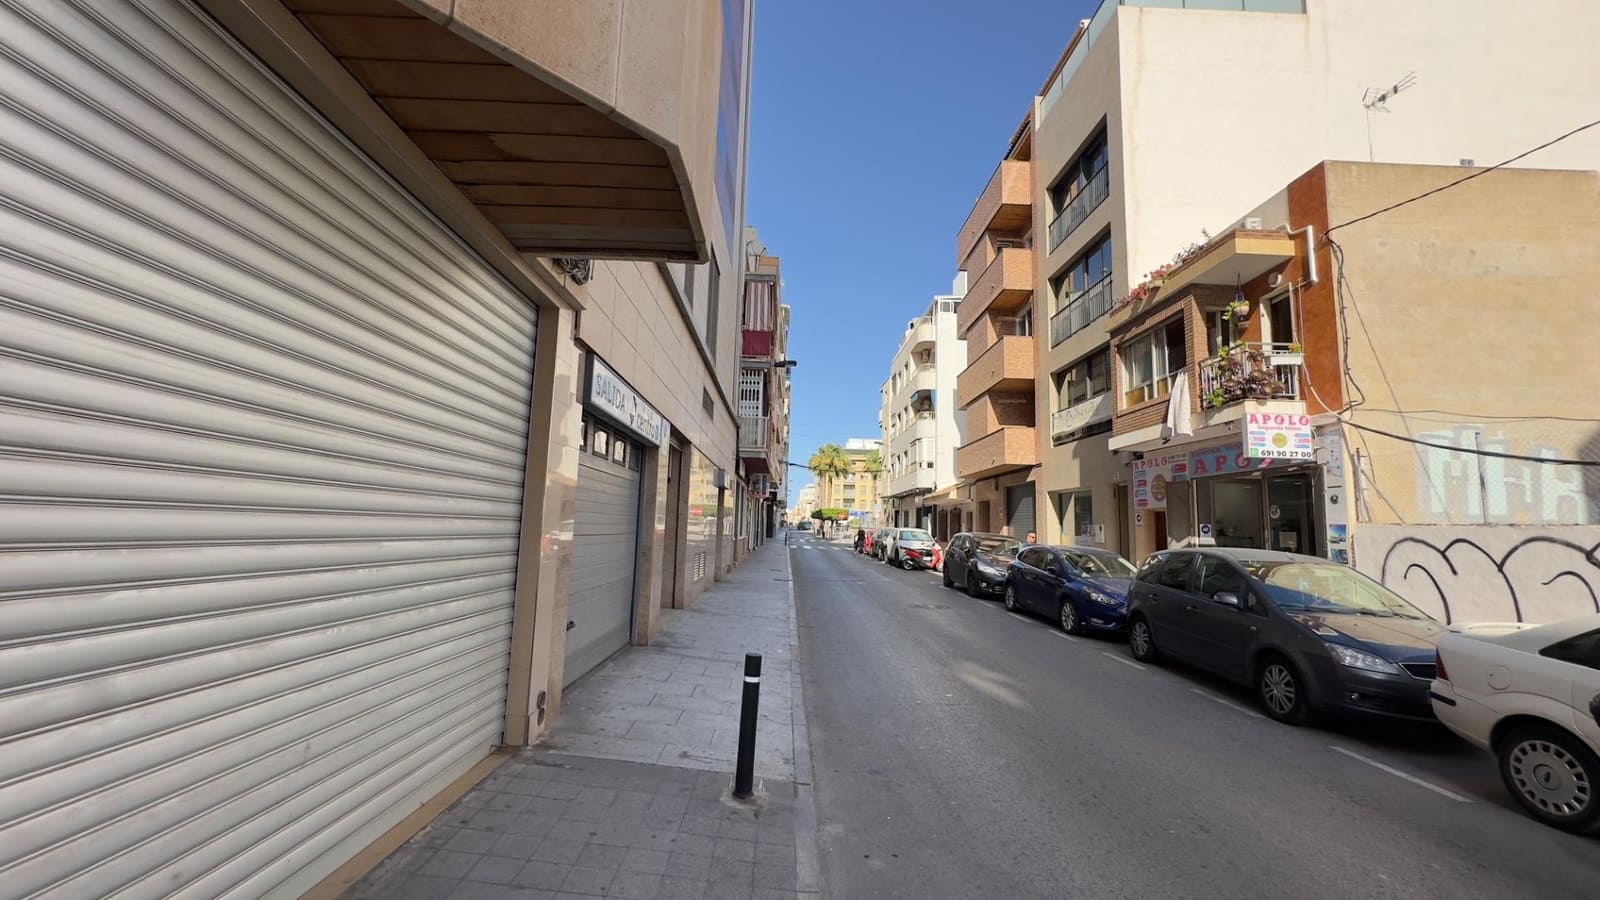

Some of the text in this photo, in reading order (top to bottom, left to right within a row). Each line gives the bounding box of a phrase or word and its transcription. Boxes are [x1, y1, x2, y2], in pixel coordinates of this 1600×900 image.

[596, 373, 626, 412] SALIDA
[1249, 413, 1310, 426] APOLO
[1134, 456, 1168, 470] APOLO
